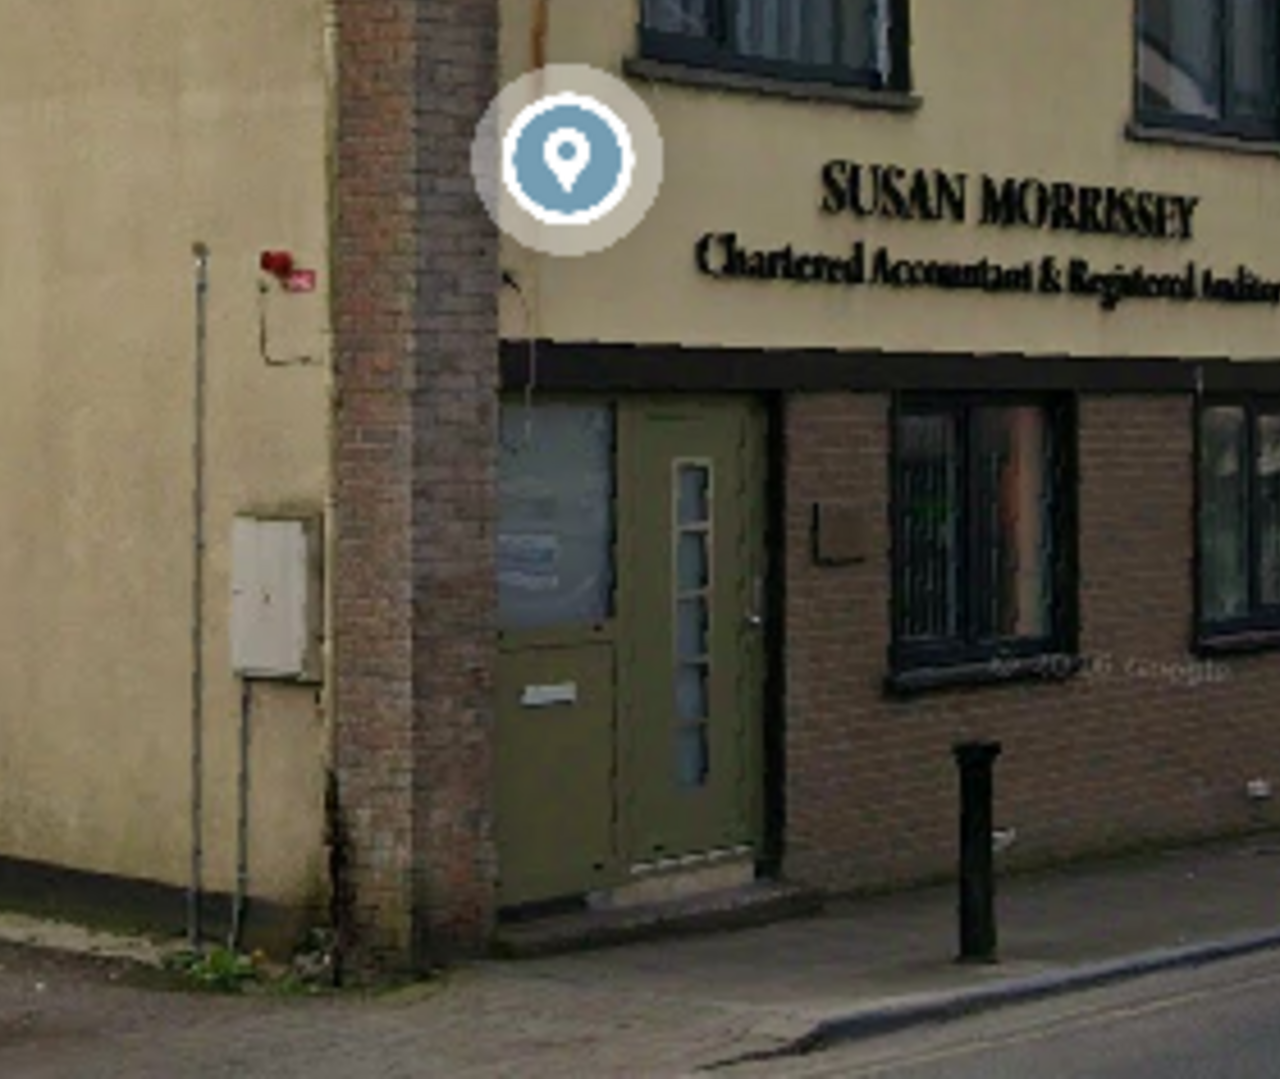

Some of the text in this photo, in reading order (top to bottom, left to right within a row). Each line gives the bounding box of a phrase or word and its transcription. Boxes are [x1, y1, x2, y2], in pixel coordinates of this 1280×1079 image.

[819, 159, 1201, 241] SUSAN MORRISSEY
[694, 232, 865, 283] Chartered
[870, 247, 1033, 293] Accountant
[1037, 256, 1062, 293] &
[1066, 259, 1197, 311] Registered
